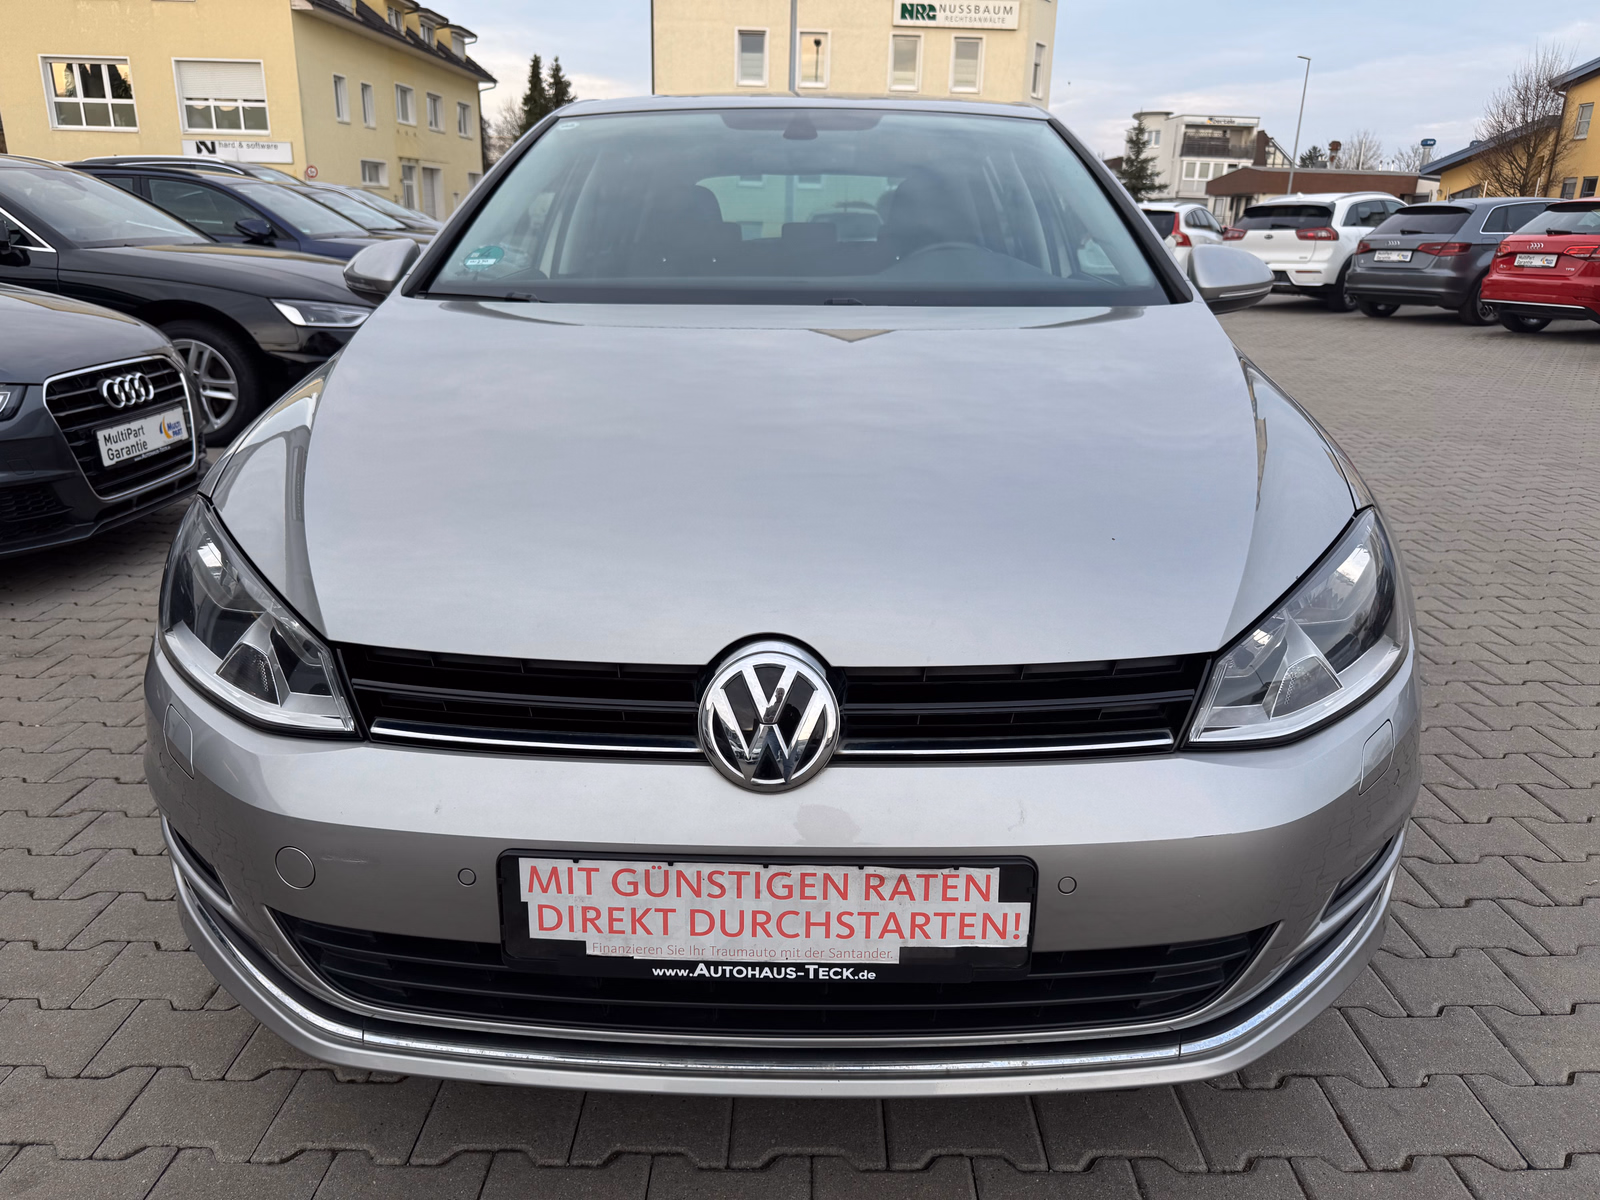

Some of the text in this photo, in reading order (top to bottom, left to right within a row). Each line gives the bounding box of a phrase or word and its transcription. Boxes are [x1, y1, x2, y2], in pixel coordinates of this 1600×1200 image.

[939, 4, 1013, 15] NUSSBAUM
[944, 15, 1006, 24] RECHTSANWÄLTE
[218, 141, 236, 149] hard
[246, 142, 279, 150] software
[103, 424, 145, 447] MultiPart
[106, 439, 148, 461] Garantie
[527, 865, 991, 902] MIT GÜNSTIGEN RATEN
[537, 903, 1021, 940] DIREKT DURCHSTARTEN!
[592, 942, 893, 959] Finanzieren Sie Ihr Traumauto mit der Santander.
